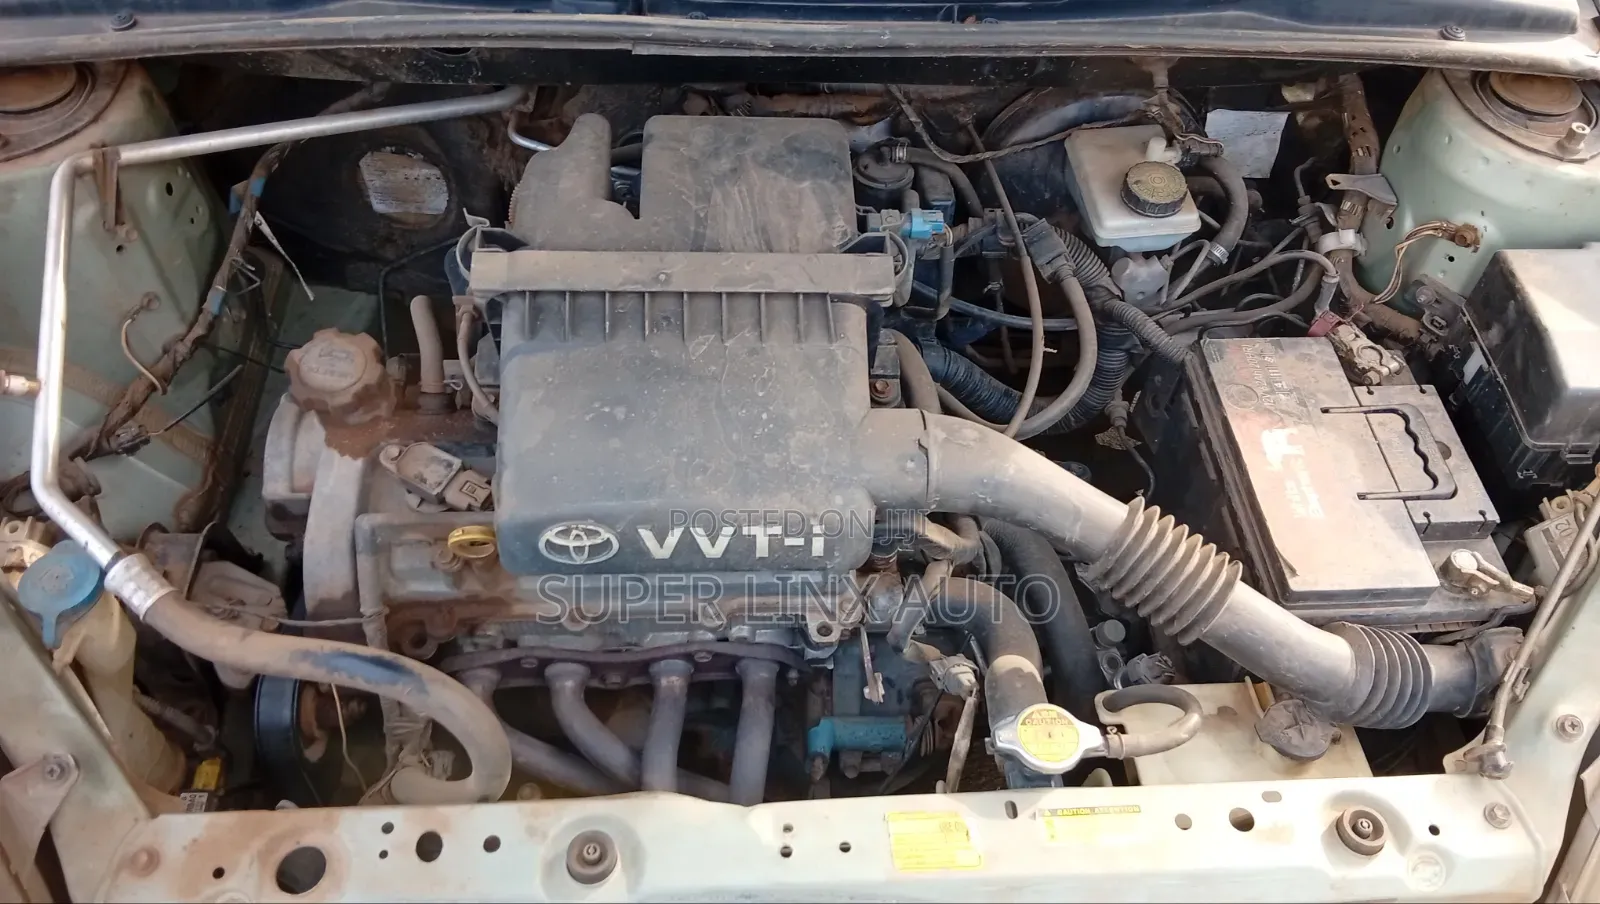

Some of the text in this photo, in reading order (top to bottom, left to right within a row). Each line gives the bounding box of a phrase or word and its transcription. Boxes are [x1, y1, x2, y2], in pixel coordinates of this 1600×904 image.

[637, 525, 825, 560] VVT-i
[1025, 718, 1069, 726] CAUTION
[1056, 805, 1140, 816] CAUTION ATTENTION
